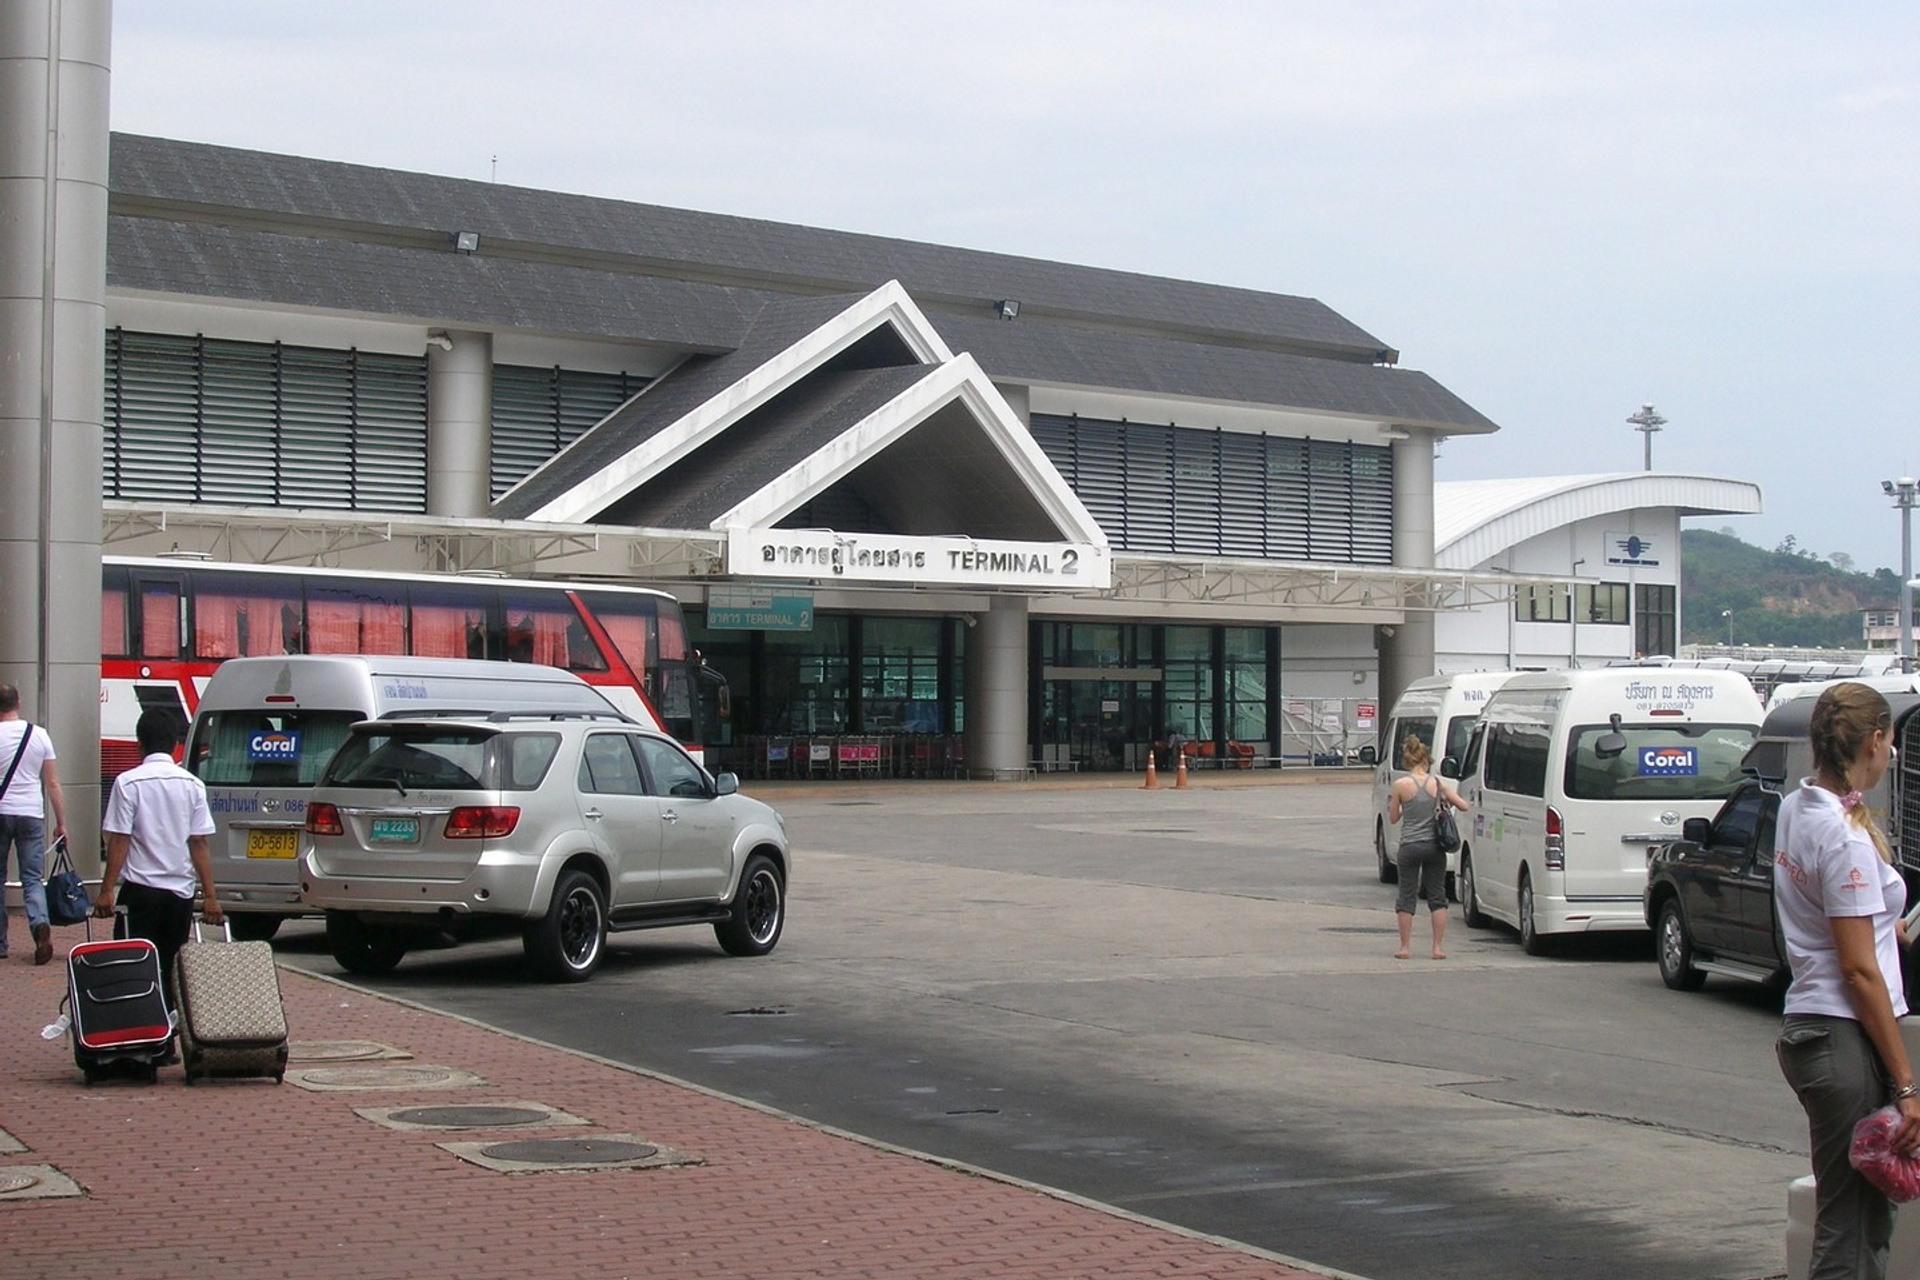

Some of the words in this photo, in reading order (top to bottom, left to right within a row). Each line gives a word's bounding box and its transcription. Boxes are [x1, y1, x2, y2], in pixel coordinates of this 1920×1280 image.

[762, 540, 925, 575] อาคารผู้โดยสาร
[947, 550, 1054, 574] TERMINAL
[1061, 549, 1079, 575] 2
[745, 613, 793, 625] TERMINAL
[800, 611, 809, 627] 2
[252, 736, 296, 752] Coral
[1644, 751, 1693, 767] Coral
[250, 835, 296, 851] 30-5613
